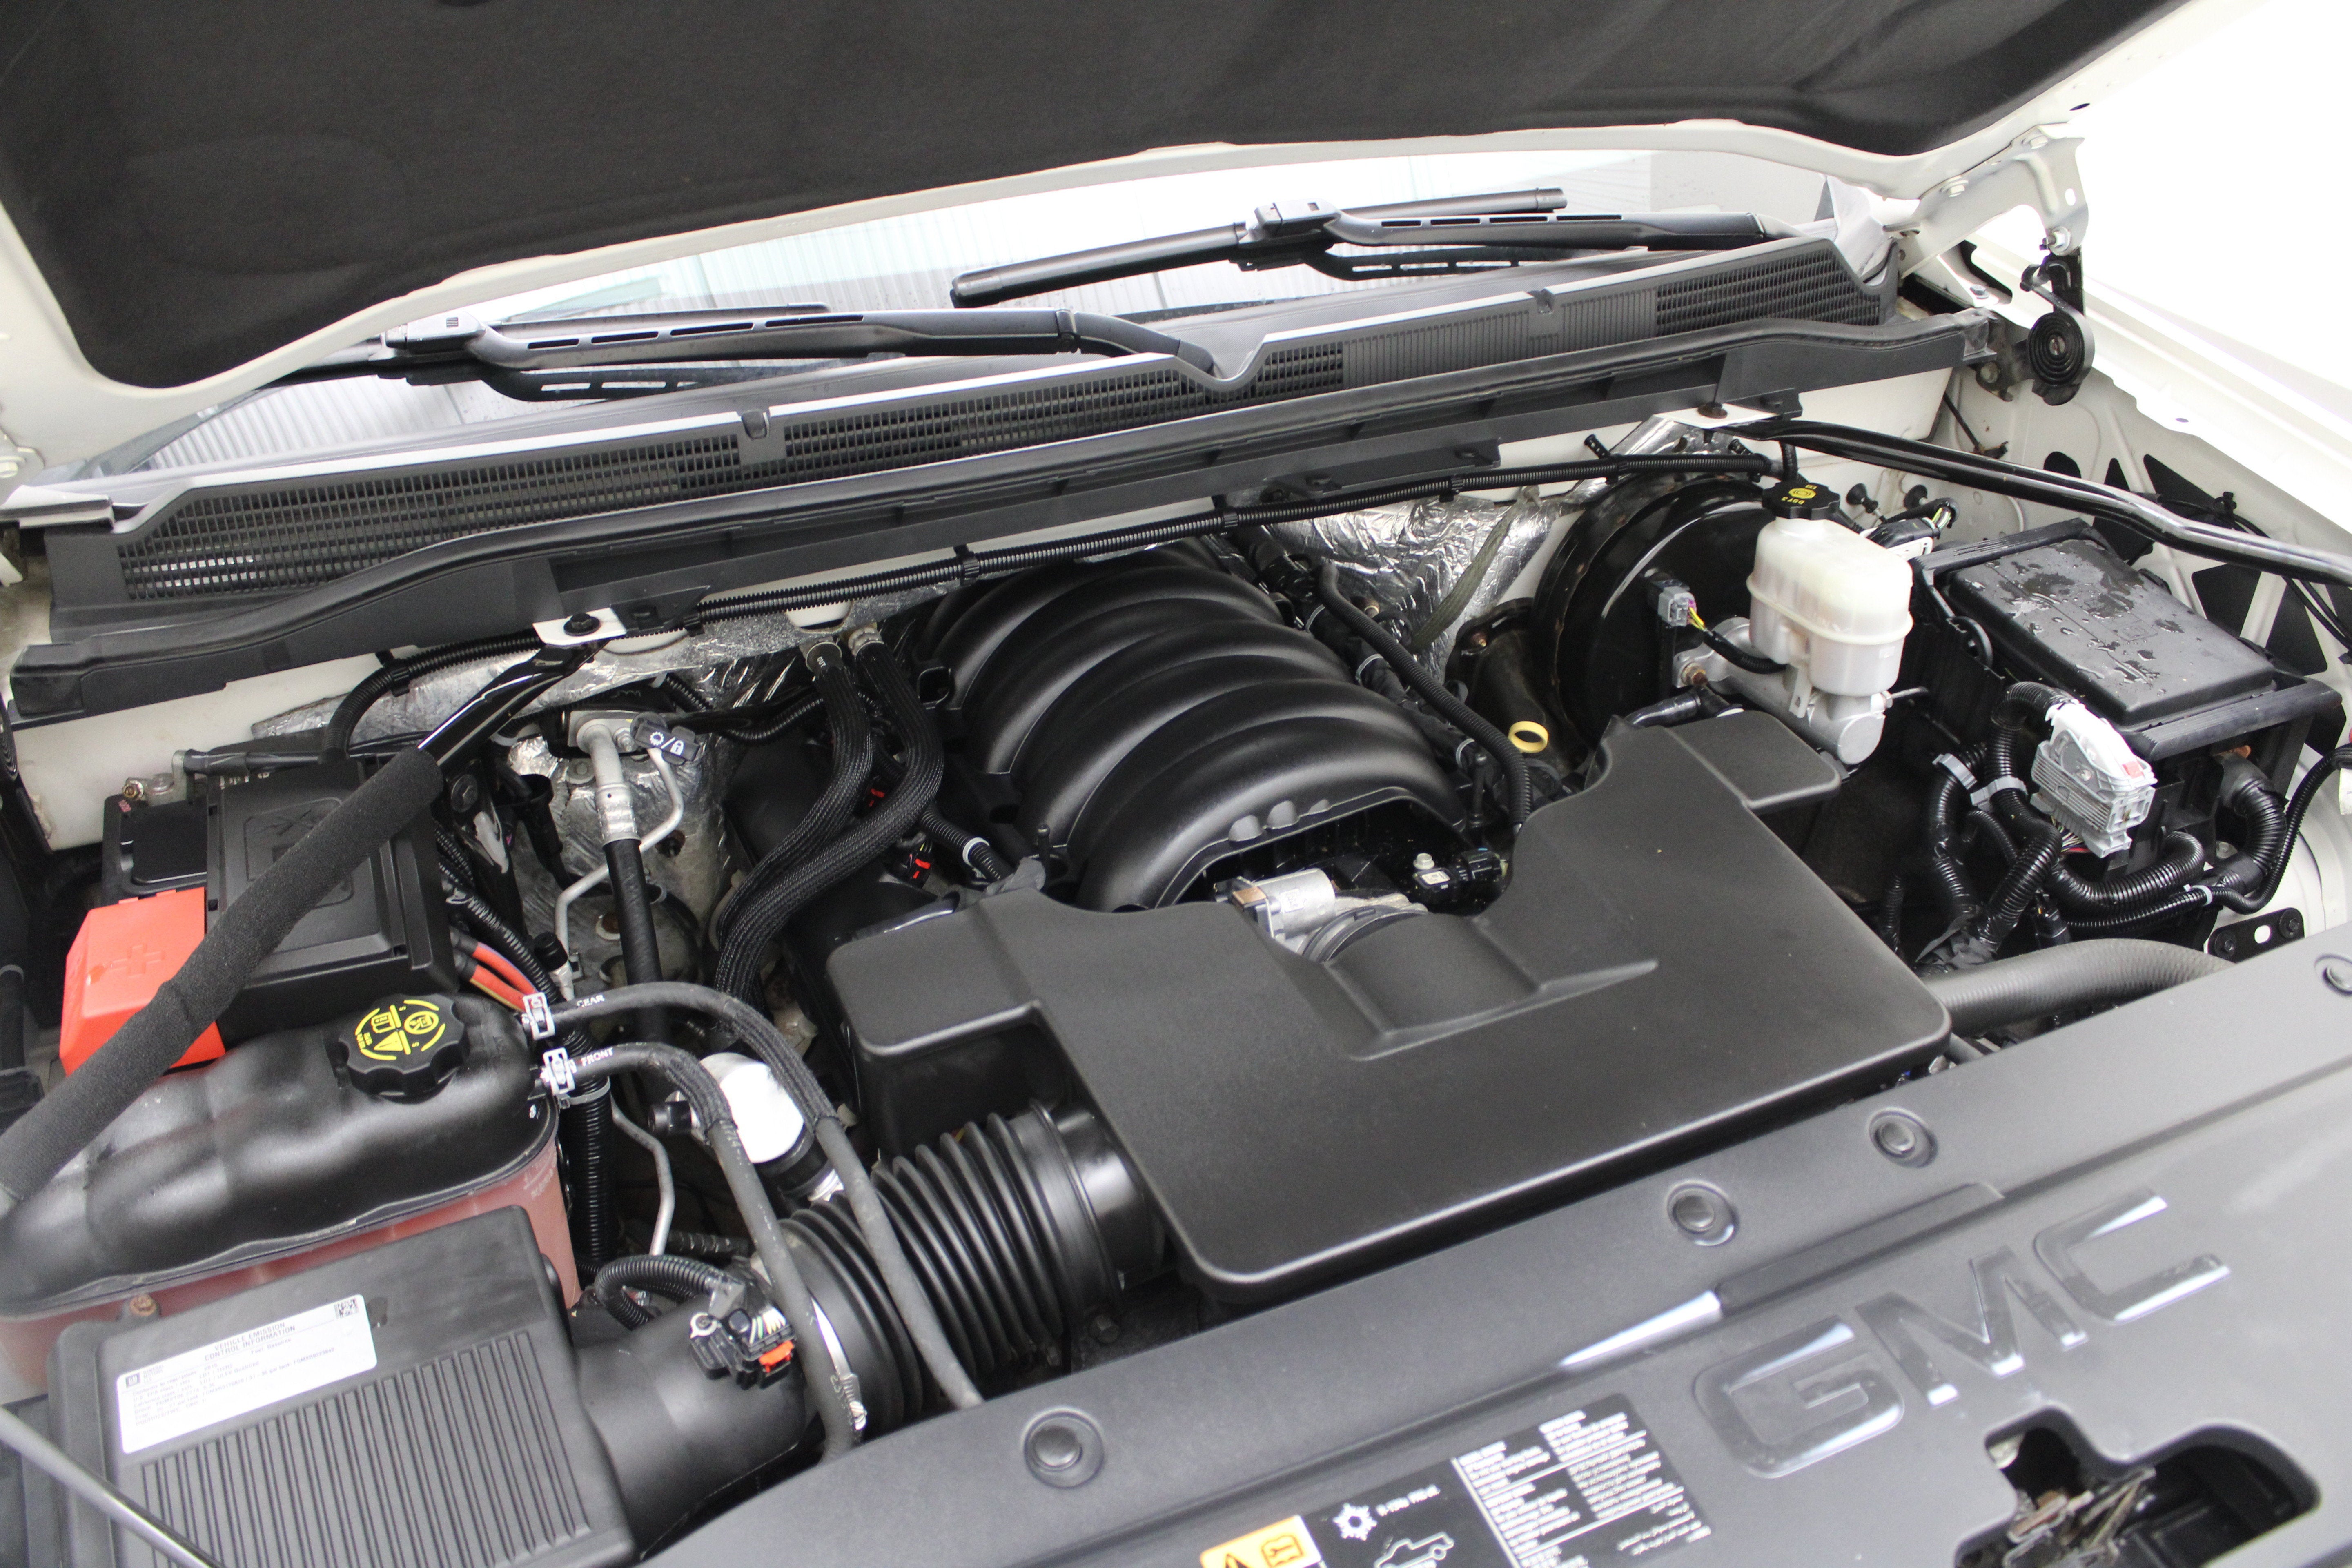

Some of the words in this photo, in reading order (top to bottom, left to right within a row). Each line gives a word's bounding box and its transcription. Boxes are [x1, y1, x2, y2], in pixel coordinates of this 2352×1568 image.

[817, 656, 826, 668] OUT
[581, 1047, 614, 1067] FRONT
[204, 1344, 239, 1361] CONTROL
[242, 1324, 296, 1348] INFORMATION
[214, 1335, 245, 1351] VEHICLE
[248, 1322, 285, 1339] EMISSION
[1692, 1188, 2231, 1479] GMC
